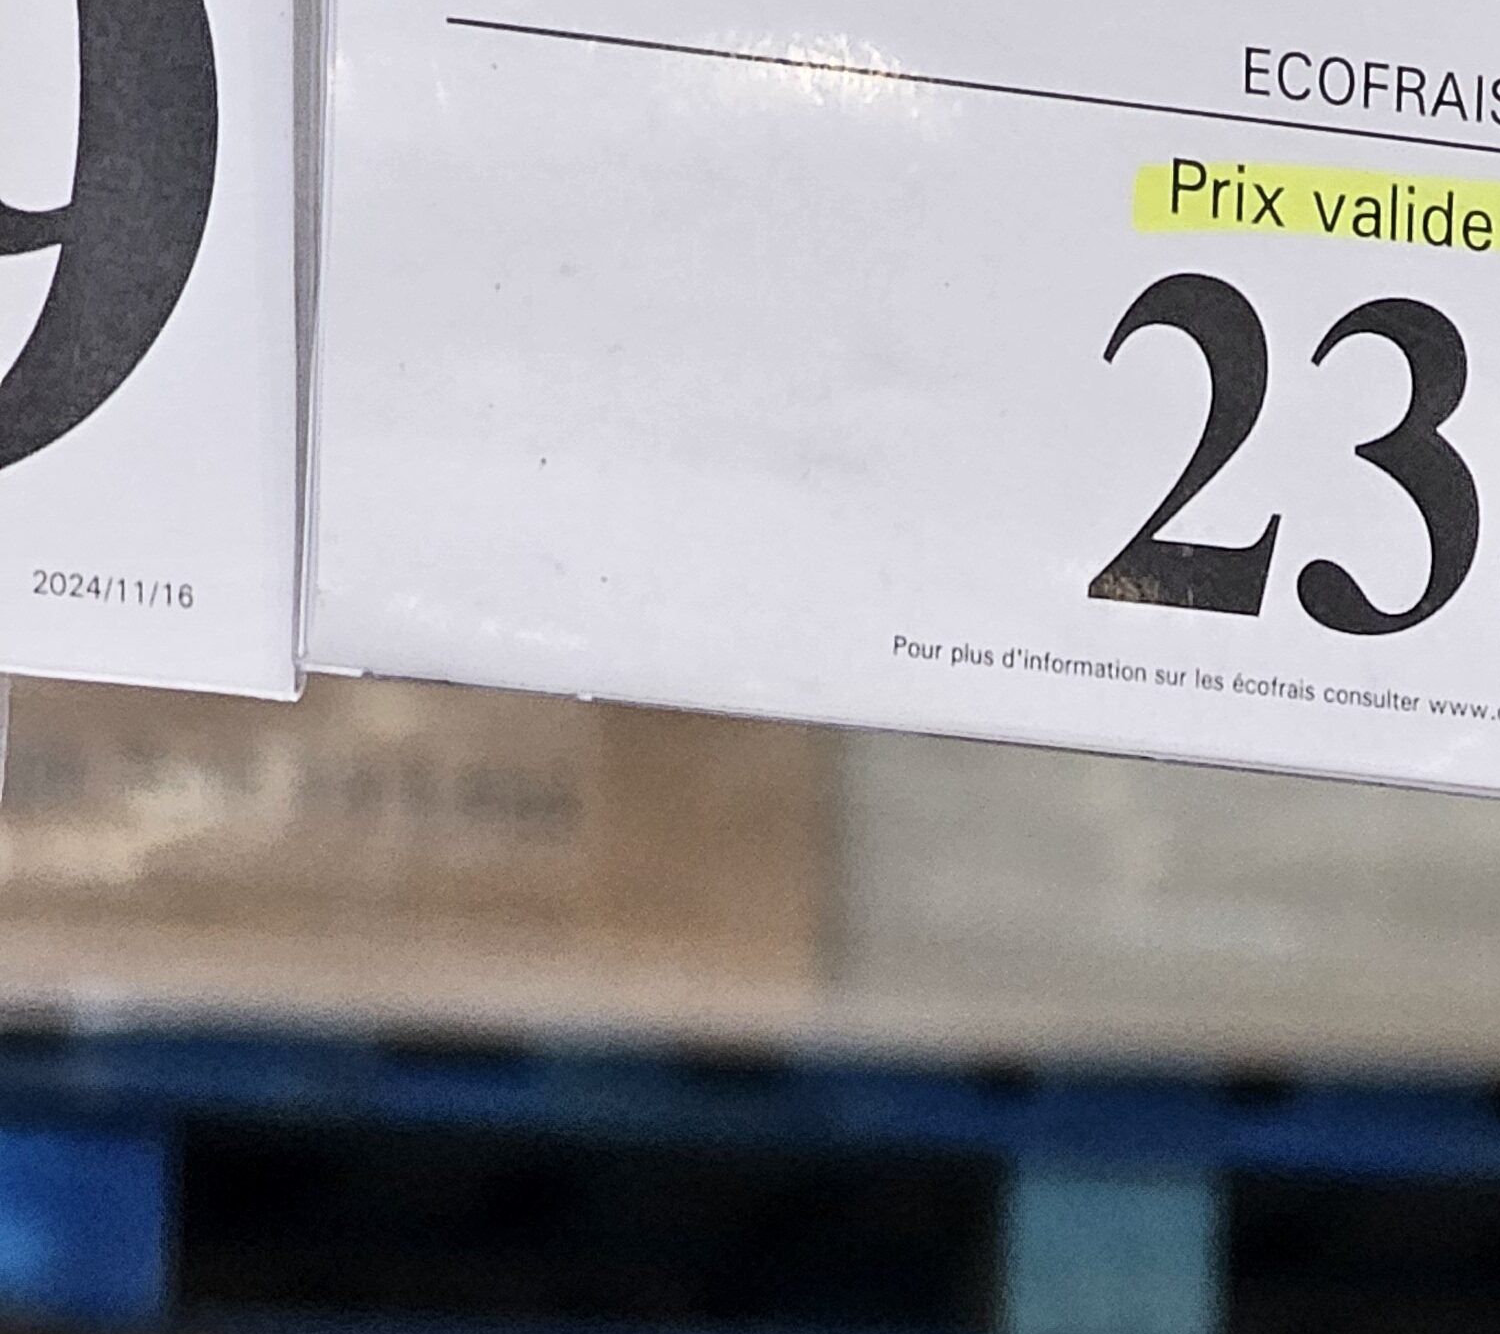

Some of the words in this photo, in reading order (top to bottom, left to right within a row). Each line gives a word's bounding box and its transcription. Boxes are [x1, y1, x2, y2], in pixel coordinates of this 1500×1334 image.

[1171, 157, 1286, 227] Prix
[1313, 183, 1494, 253] valide
[32, 569, 194, 610] 2024/11/16
[892, 634, 944, 661] Pour
[950, 642, 995, 670] plus
[1001, 647, 1147, 683] d'information
[1154, 668, 1187, 688] sur
[1195, 667, 1225, 692] les
[1232, 672, 1316, 702] écofrais
[1323, 683, 1421, 713] consulter
